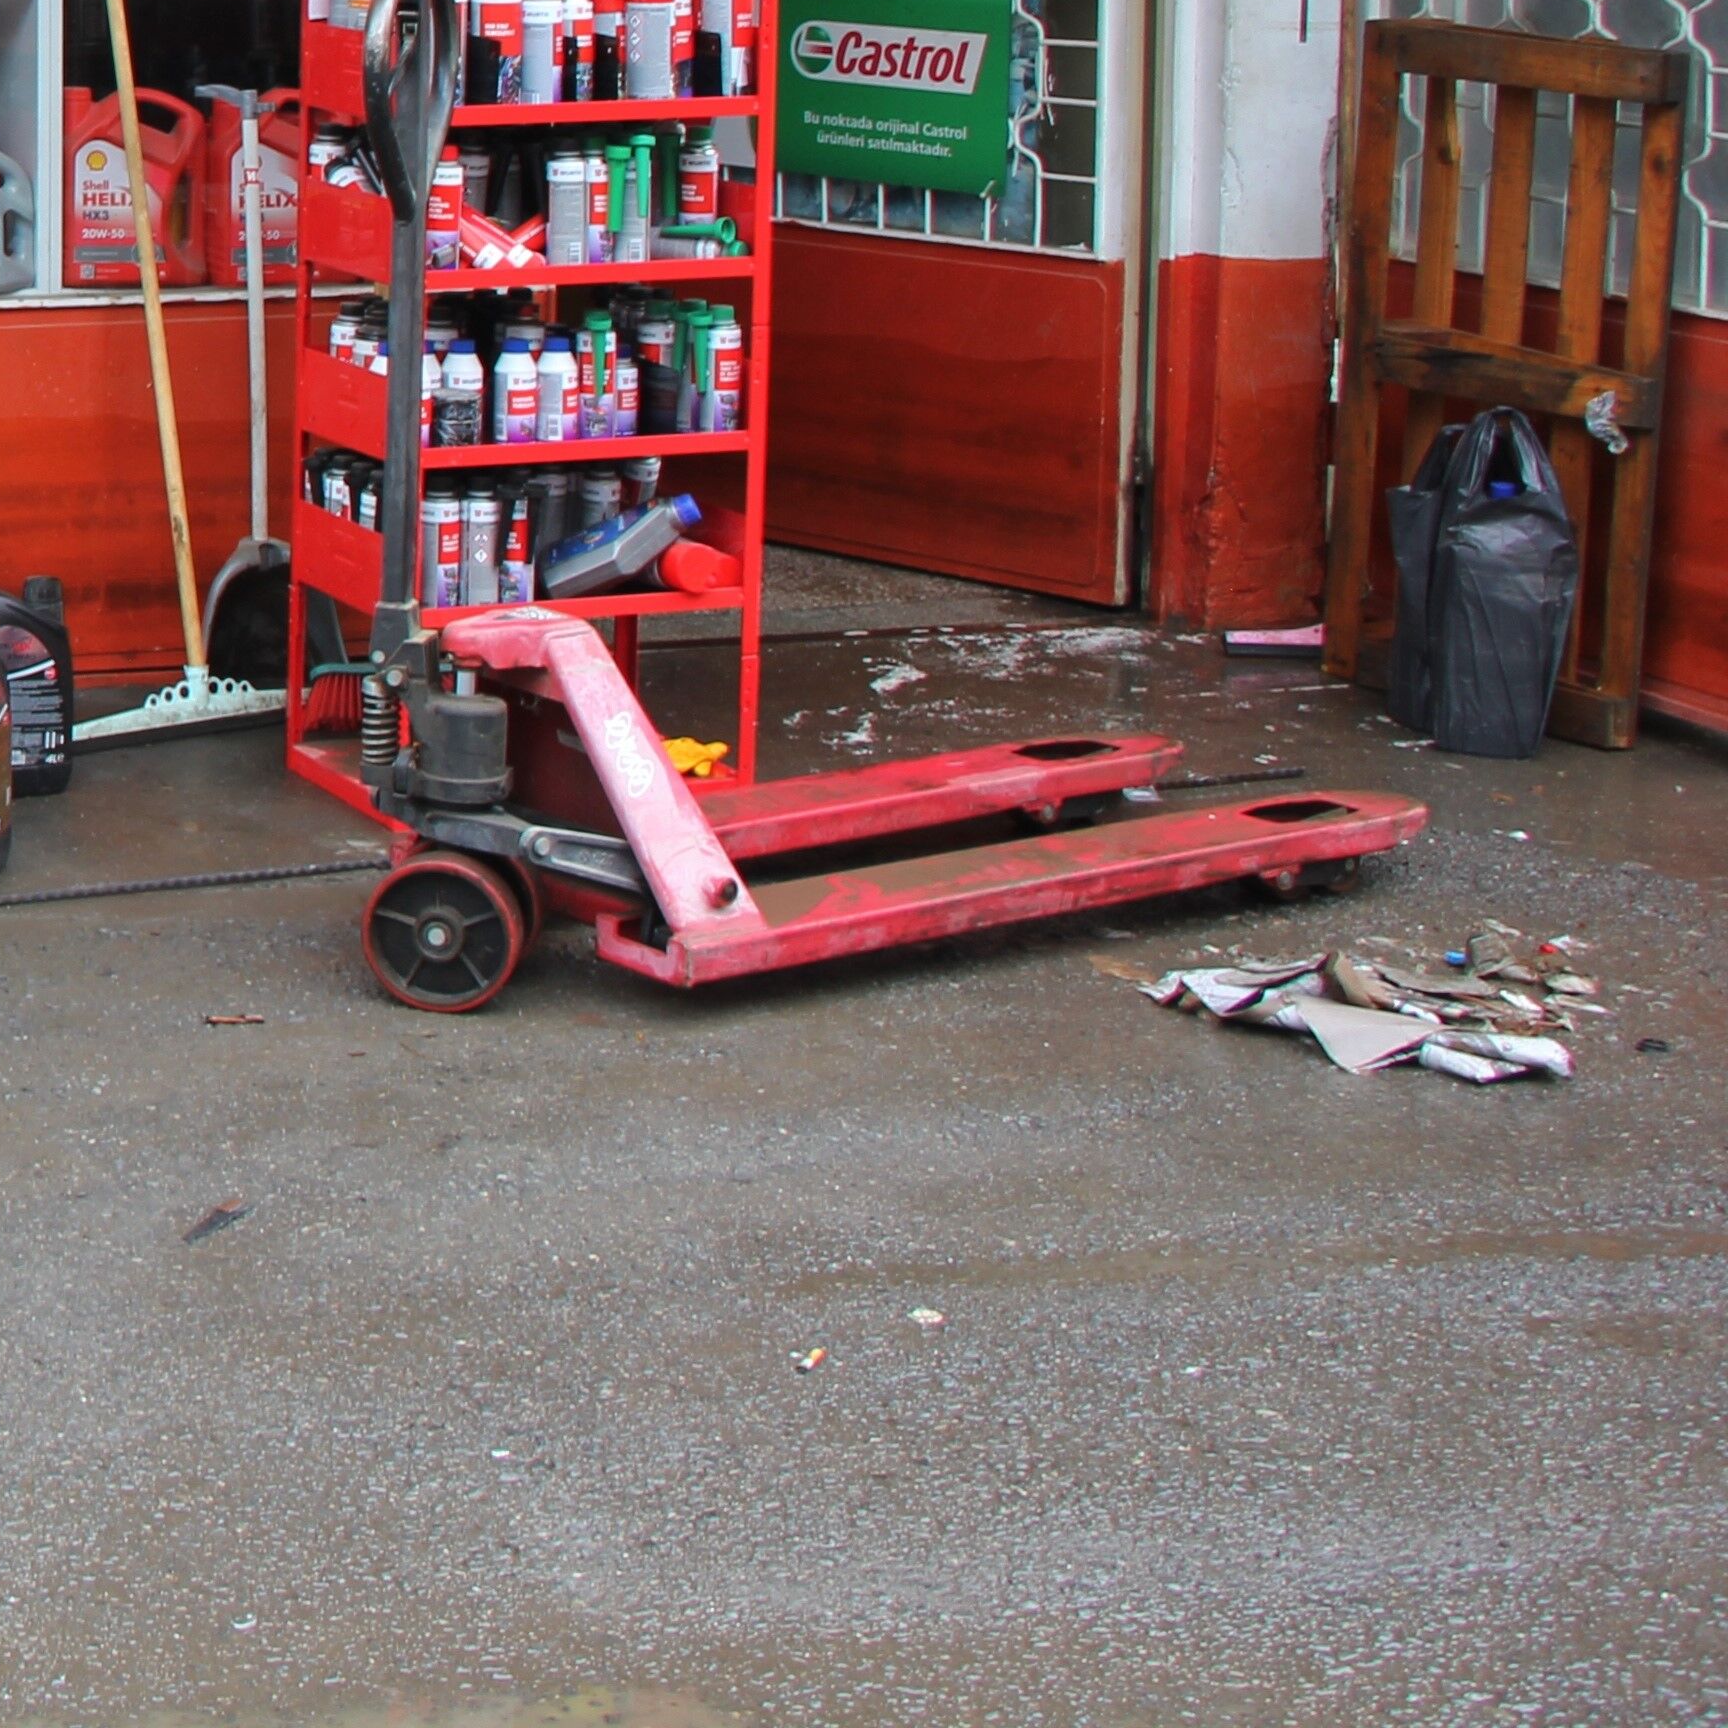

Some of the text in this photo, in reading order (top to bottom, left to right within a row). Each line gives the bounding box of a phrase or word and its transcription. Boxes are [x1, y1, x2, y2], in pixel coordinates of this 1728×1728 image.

[834, 30, 970, 85] Castrol
[803, 110, 967, 140] Bu noktada orijinal Castrol
[816, 130, 865, 148] ürünleri
[82, 180, 109, 192] Shell
[82, 210, 109, 221] HX3
[81, 228, 126, 240] 20W-50
